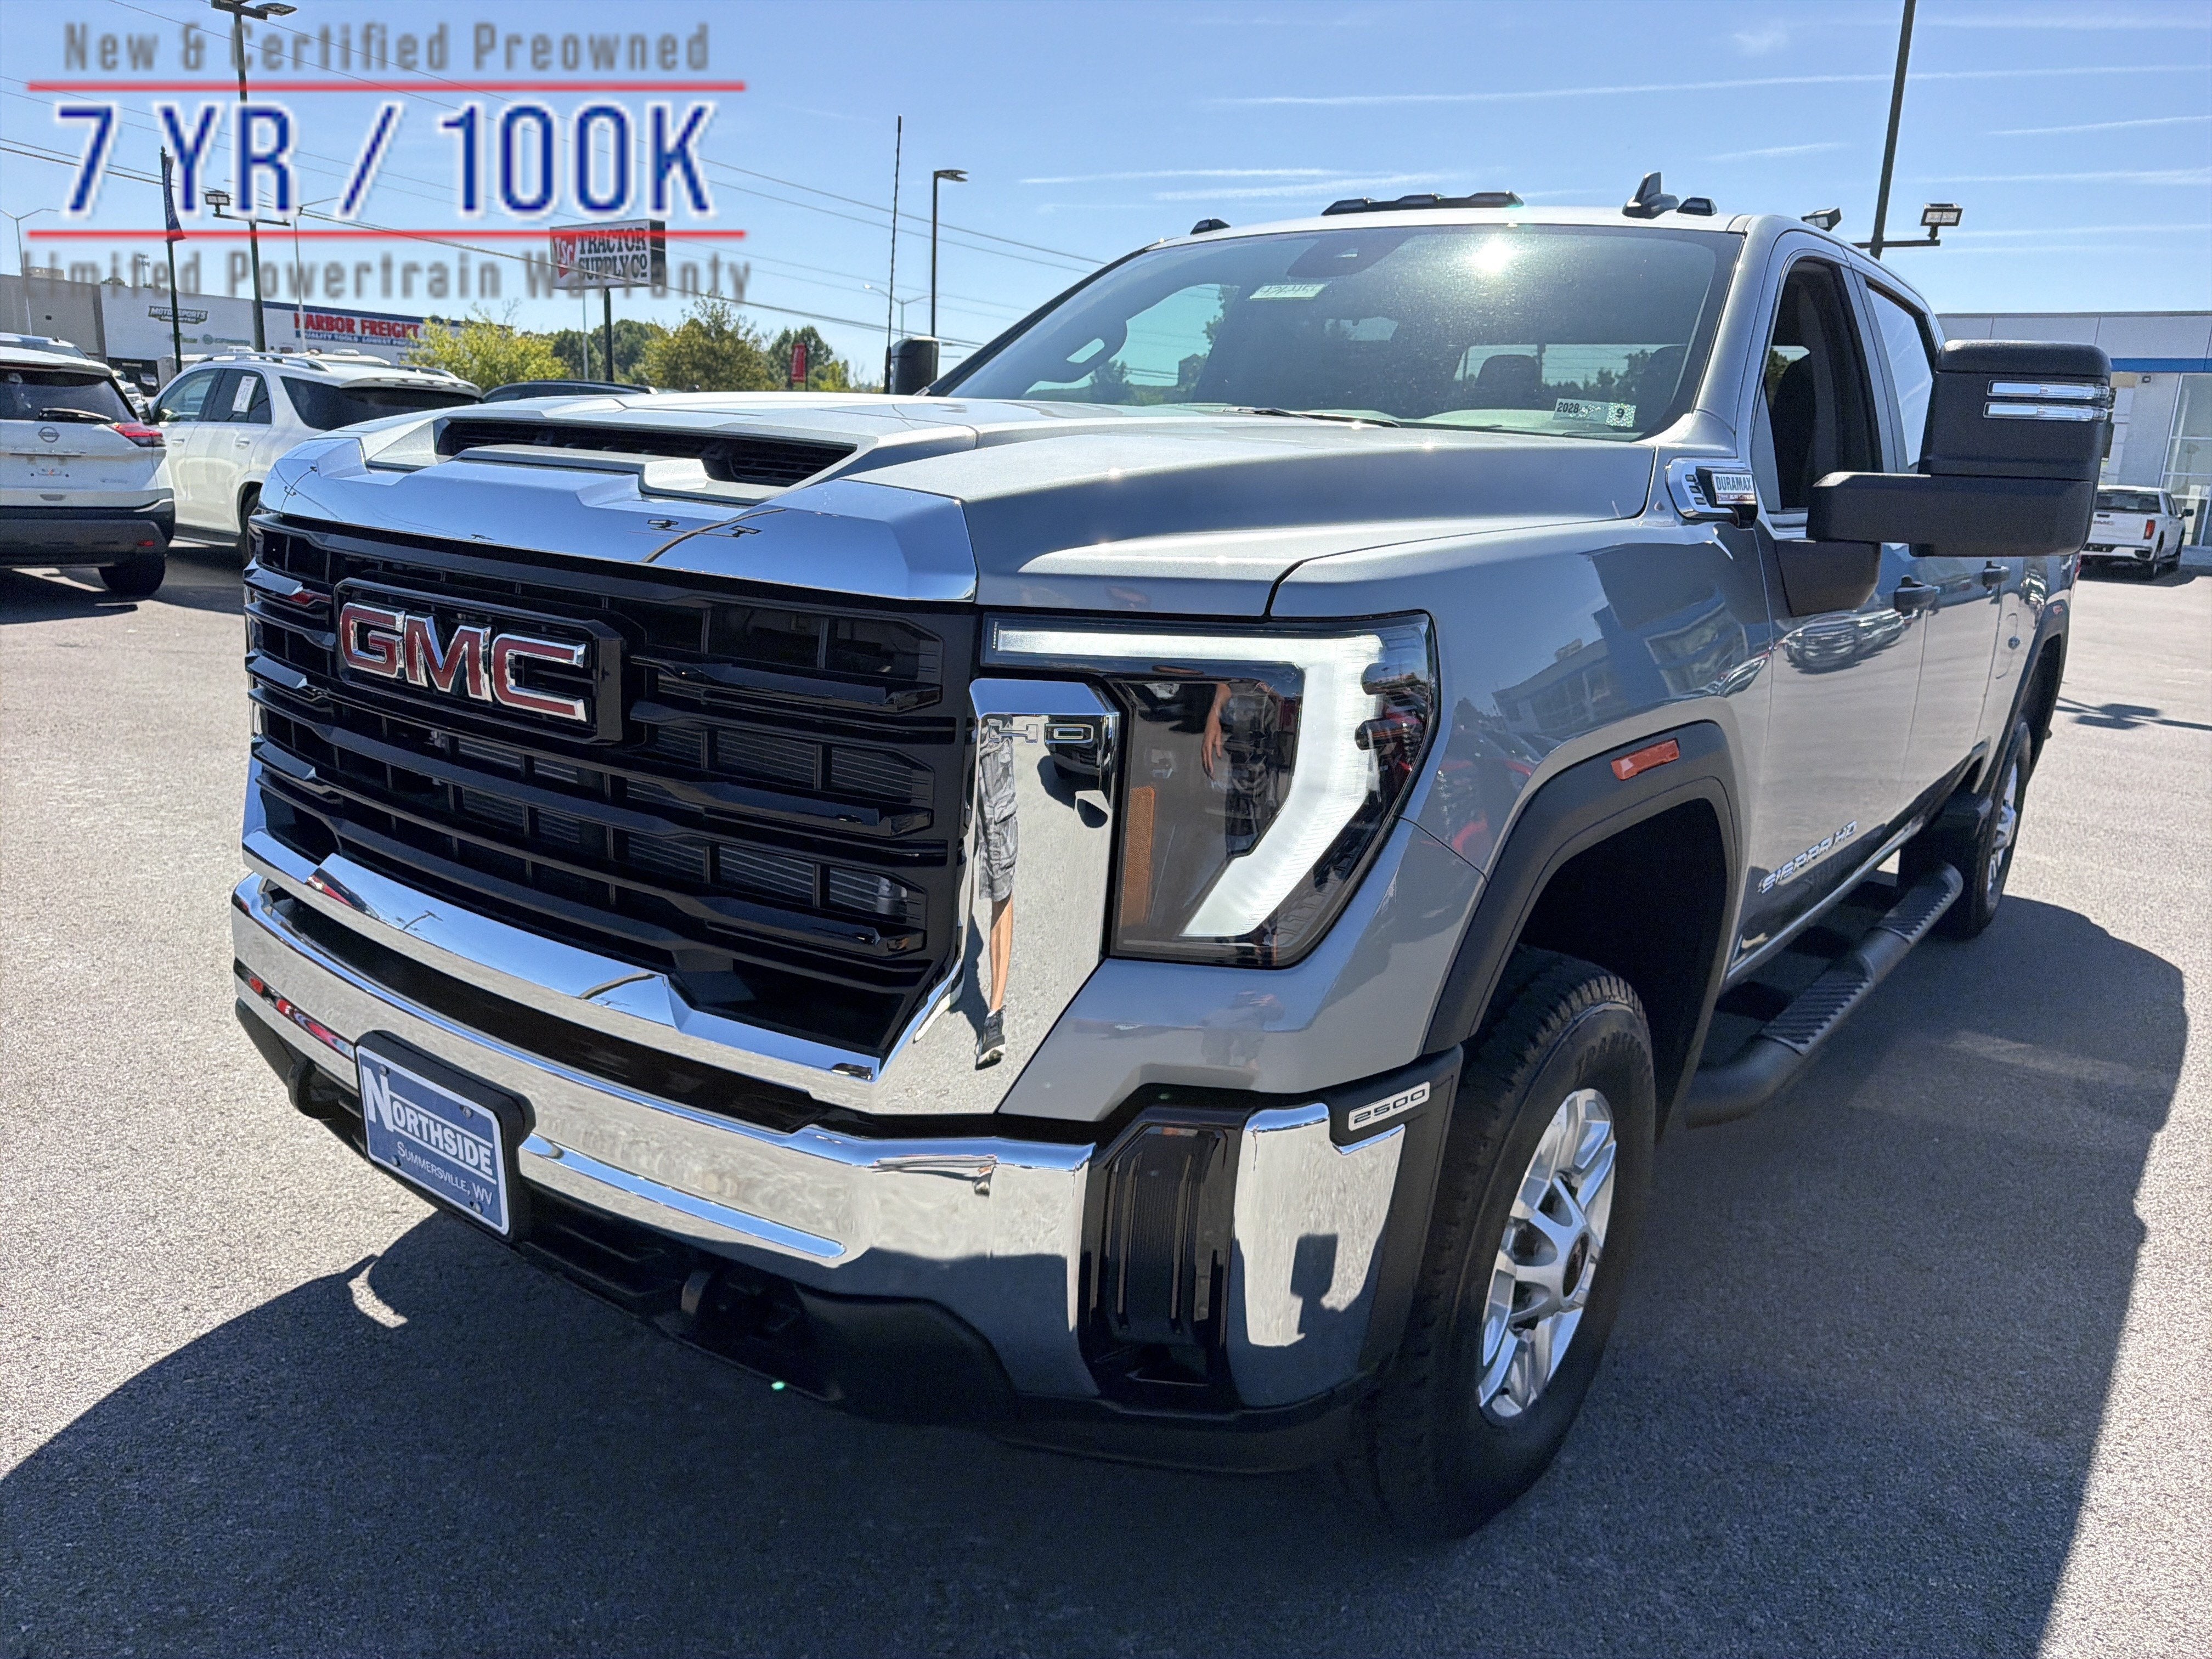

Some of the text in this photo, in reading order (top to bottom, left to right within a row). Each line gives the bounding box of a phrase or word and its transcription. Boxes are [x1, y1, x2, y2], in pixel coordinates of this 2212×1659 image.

[578, 228, 647, 254] TRACTOR
[579, 255, 629, 280] SUPPLY
[150, 307, 206, 319] MOTOSPORTS
[1557, 402, 1580, 414] 2028
[1616, 408, 1625, 418] 9
[1715, 476, 1752, 492] DURAMAX
[339, 602, 587, 722] GMC
[988, 719, 1094, 744] HD
[1757, 837, 1832, 894] SIERRA
[1353, 1088, 1426, 1125] 2500
[362, 1065, 494, 1176] NORTHSIDE
[397, 1141, 493, 1205] SUMMERSVILLE, WV
